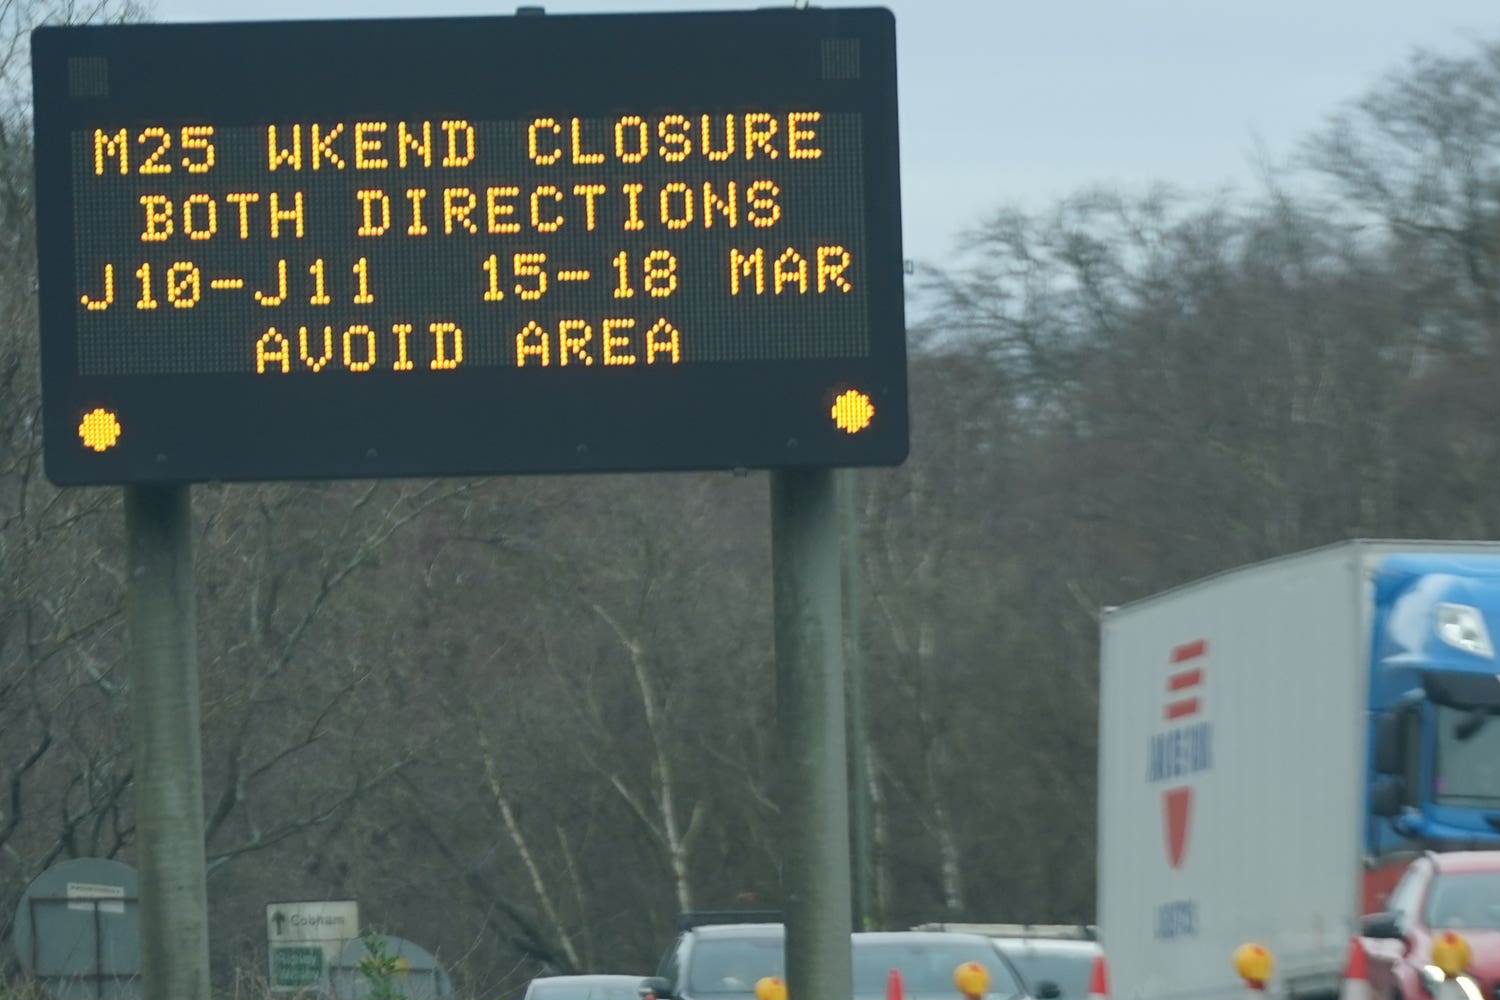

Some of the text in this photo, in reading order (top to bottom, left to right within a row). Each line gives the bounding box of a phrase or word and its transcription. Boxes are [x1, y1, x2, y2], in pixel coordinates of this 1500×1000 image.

[94, 111, 823, 176] M25 WKEND CLOSURE
[139, 180, 781, 242] BOTH DIRECTIONS
[80, 245, 852, 311] J10-J11 15-18 MAR
[255, 317, 680, 374] AVOID AREA
